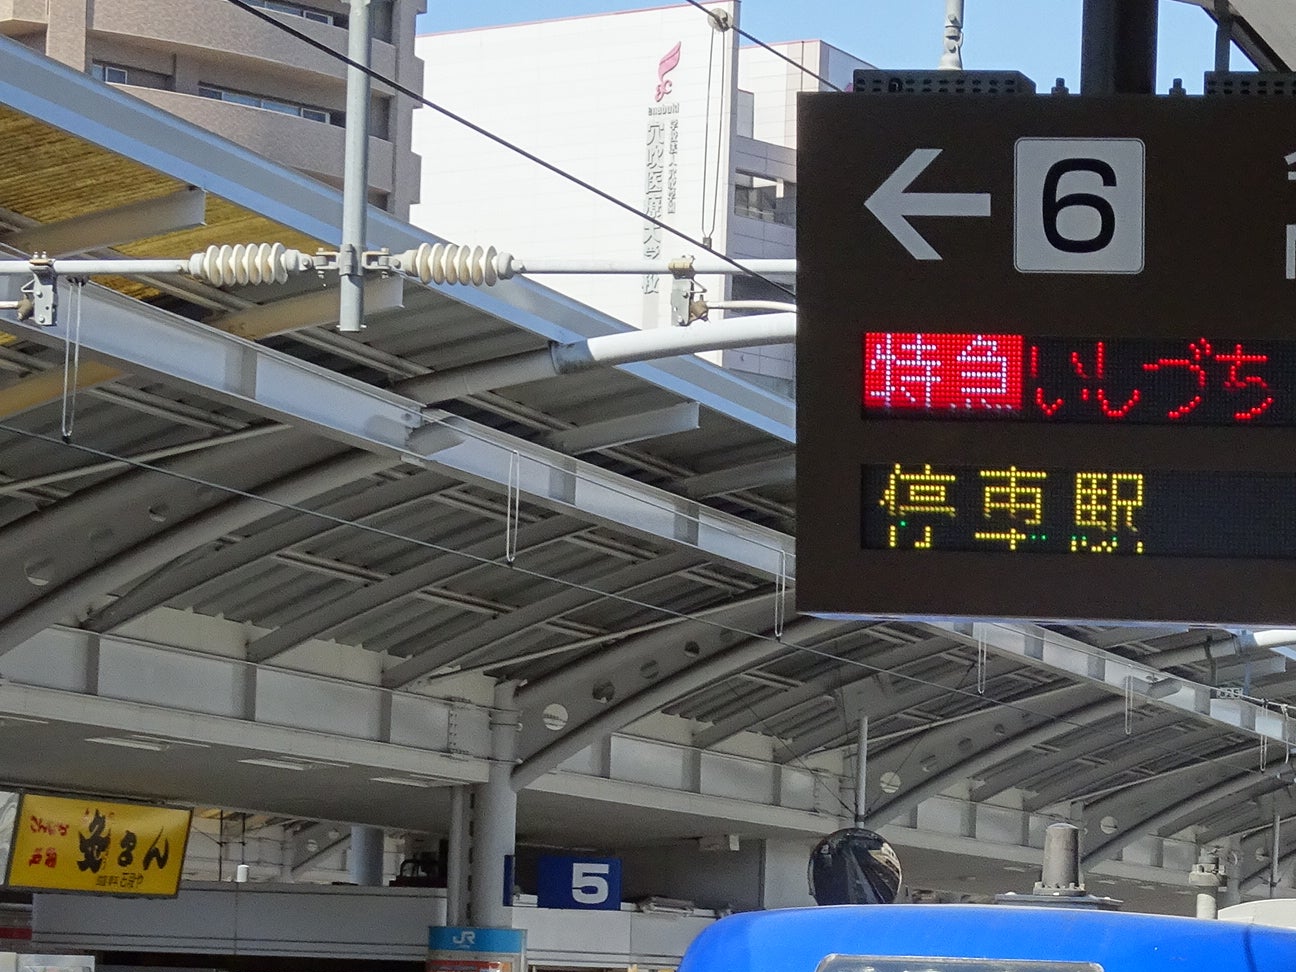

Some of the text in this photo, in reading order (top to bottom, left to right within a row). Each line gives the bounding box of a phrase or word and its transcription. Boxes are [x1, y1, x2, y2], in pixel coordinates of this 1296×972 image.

[1041, 157, 1118, 253] 6
[868, 333, 1012, 411] 特急
[1030, 338, 1274, 419] いしづち
[879, 463, 1146, 554] 停車駅
[571, 862, 610, 904] 5
[452, 931, 476, 945] JR
